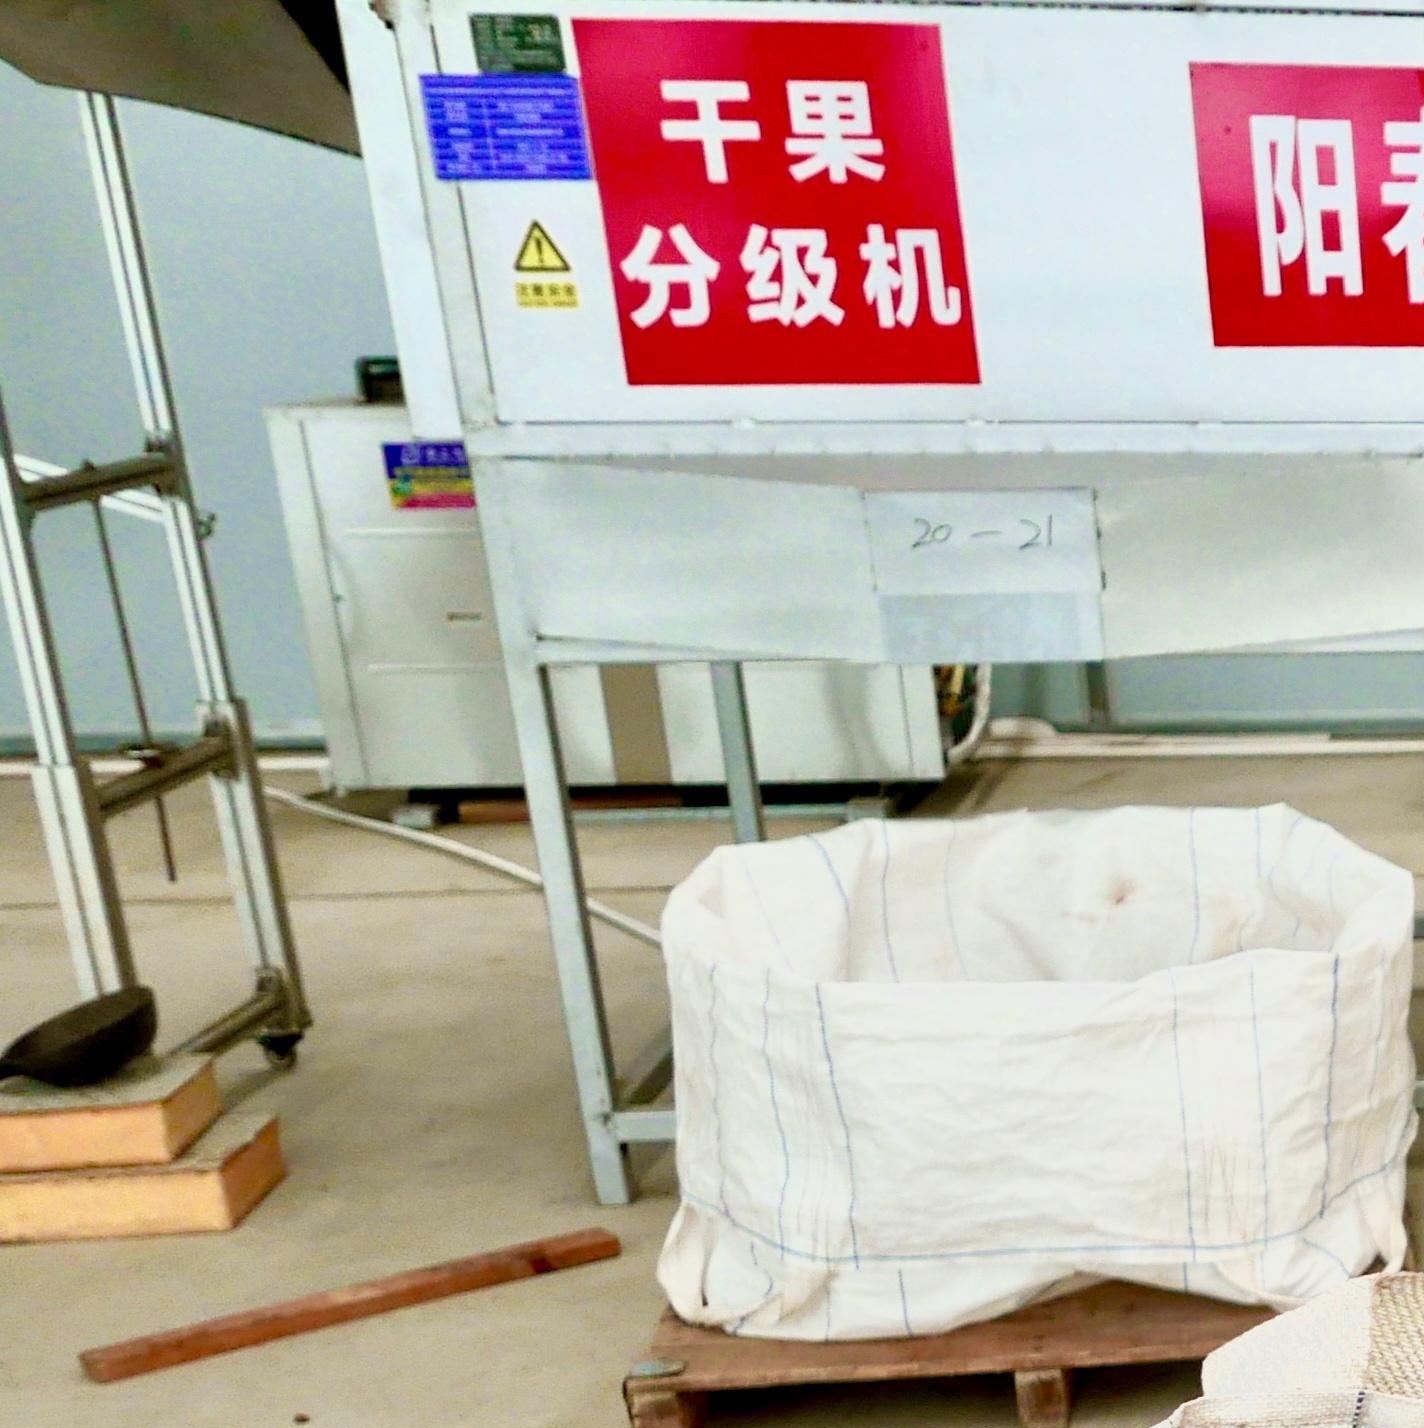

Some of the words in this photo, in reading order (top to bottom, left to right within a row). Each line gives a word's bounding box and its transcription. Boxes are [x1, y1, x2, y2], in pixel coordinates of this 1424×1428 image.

[660, 79, 886, 184] 干果
[620, 223, 962, 330] 分级机
